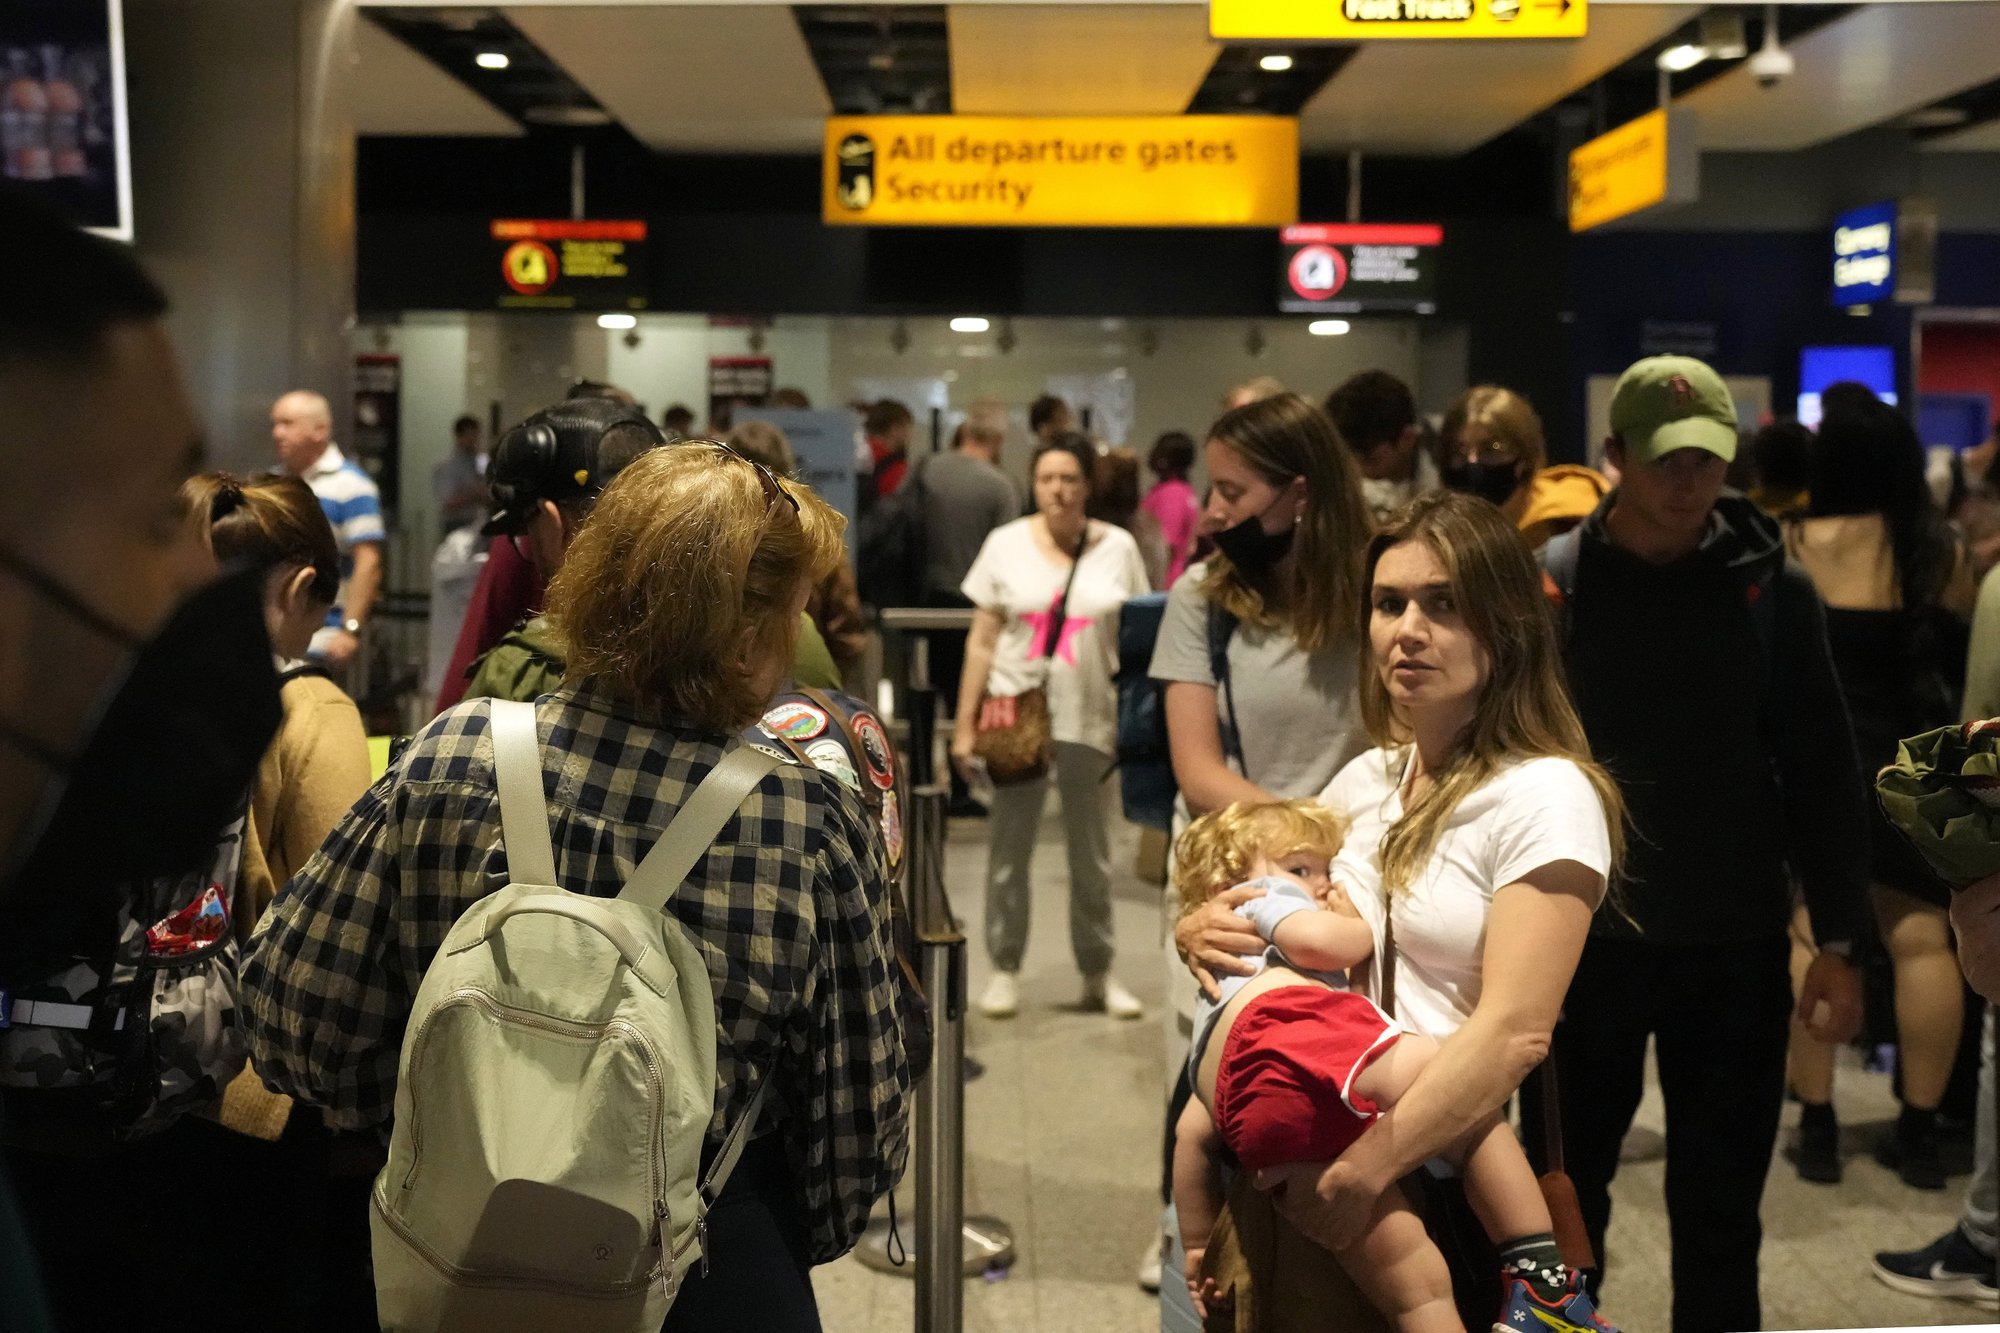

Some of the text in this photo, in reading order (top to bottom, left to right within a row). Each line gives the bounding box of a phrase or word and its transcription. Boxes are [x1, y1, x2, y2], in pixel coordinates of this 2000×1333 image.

[888, 134, 1238, 172] All departure gates
[887, 175, 1033, 210] Security
